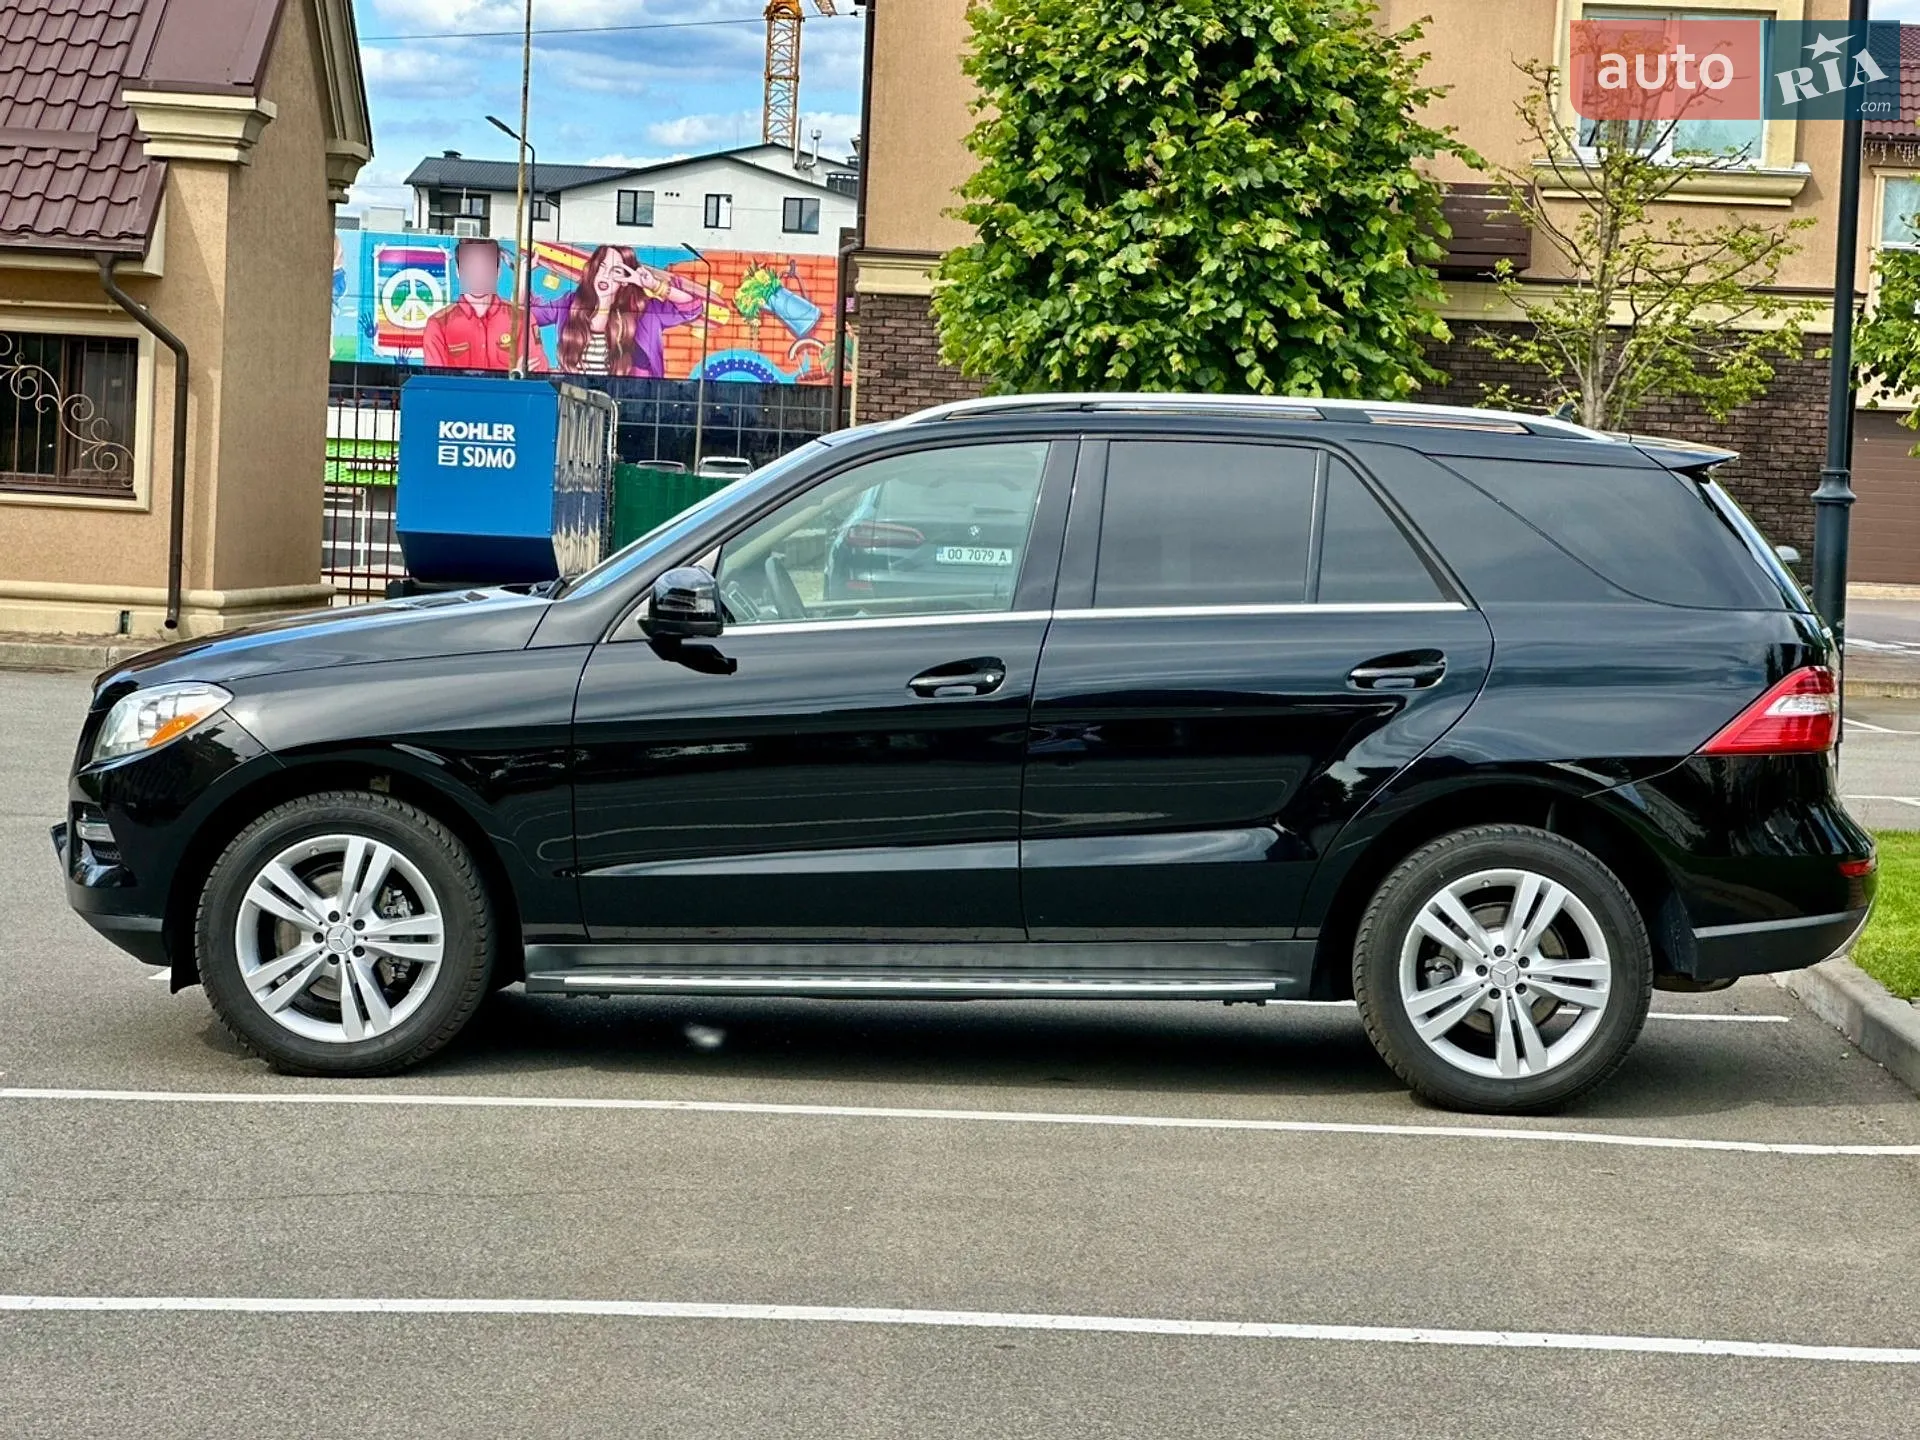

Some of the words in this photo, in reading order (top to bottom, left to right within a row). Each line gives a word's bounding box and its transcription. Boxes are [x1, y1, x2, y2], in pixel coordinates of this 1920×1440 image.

[439, 421, 516, 442] KOHLER
[462, 446, 516, 469] SDMO
[967, 549, 994, 561] 7079
